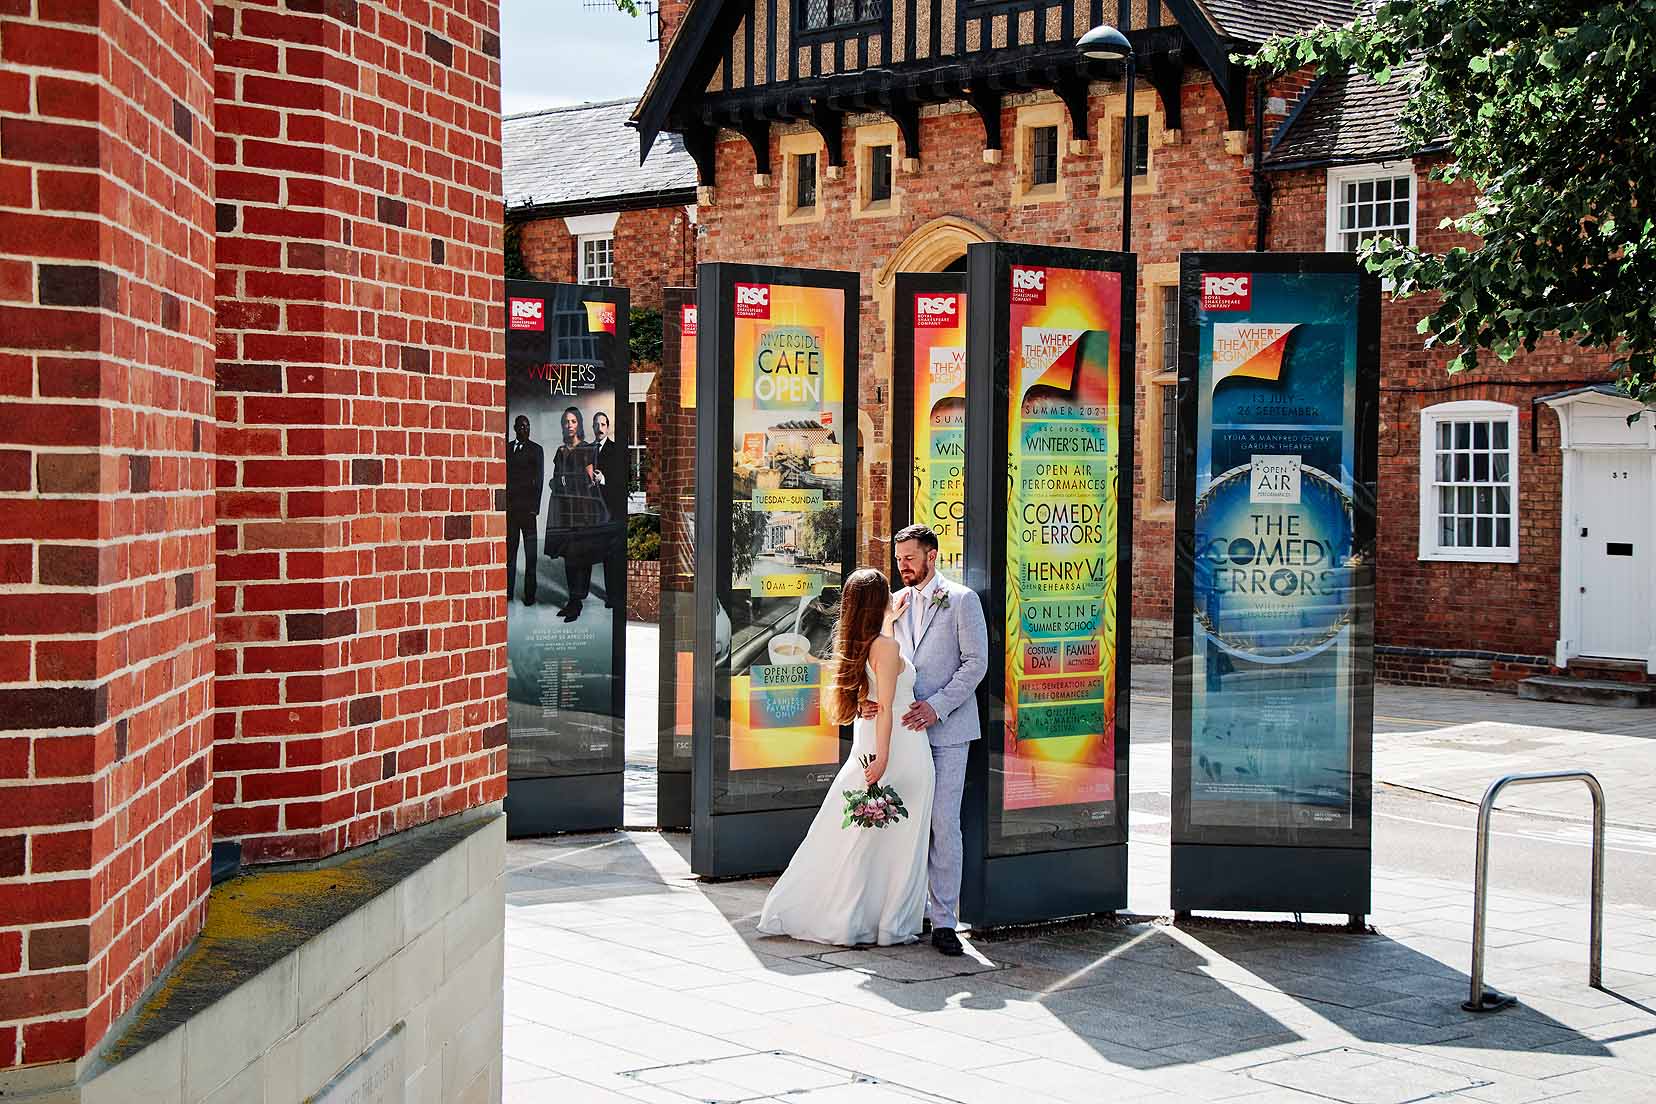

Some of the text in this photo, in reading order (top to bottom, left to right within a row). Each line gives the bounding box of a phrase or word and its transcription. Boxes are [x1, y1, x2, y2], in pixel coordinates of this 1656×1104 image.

[1013, 269, 1045, 291] RSC
[1204, 276, 1249, 296] RSC
[737, 286, 769, 306] RSC
[512, 301, 542, 319] RSC
[917, 297, 956, 315] RSC
[760, 333, 820, 349] RIVERSIDE
[1040, 333, 1073, 347] WHERE
[1237, 328, 1281, 340] WHERE
[1025, 344, 1063, 357] THEATRE
[1216, 339, 1267, 351] THEATRE
[758, 350, 819, 375] CAFE
[548, 378, 578, 396] TALE
[755, 375, 820, 402] OPEN
[1270, 393, 1296, 403] JULY
[1025, 406, 1106, 417] SUMMER 2021
[1237, 406, 1320, 417] 26 SEPTEMBER
[1026, 437, 1105, 453] WINTER'S TALE
[1223, 434, 1247, 442] LYDIA
[1249, 434, 1256, 442] &
[1258, 434, 1298, 442] MANFRED
[1036, 464, 1092, 476] OPEN AIR
[1262, 466, 1287, 474] OPEN
[932, 479, 964, 489] PERF
[1022, 479, 1106, 490] PERFORMANCES
[1257, 474, 1291, 490] AIR
[1023, 503, 1104, 525] COMEDY
[1250, 514, 1300, 536] THE
[1022, 524, 1103, 545] OF ERRORS
[1207, 537, 1338, 568] COMEDY
[1027, 561, 1083, 581] HENRY
[1038, 583, 1086, 592] REHEARSAL
[1213, 567, 1336, 597] ERRORS
[1027, 604, 1097, 620] ONLINE
[1028, 620, 1097, 633] SUMMER SCHOOL
[1027, 645, 1058, 656] COSTUME
[1066, 644, 1097, 657] FAMILY
[1031, 655, 1053, 669] DAY
[764, 666, 809, 676] OPEN FOR
[764, 674, 809, 684] EVERYONE
[1041, 681, 1085, 690] GENERATION
[1088, 679, 1101, 688] ACT
[1034, 689, 1089, 700] PERFORMANCES
